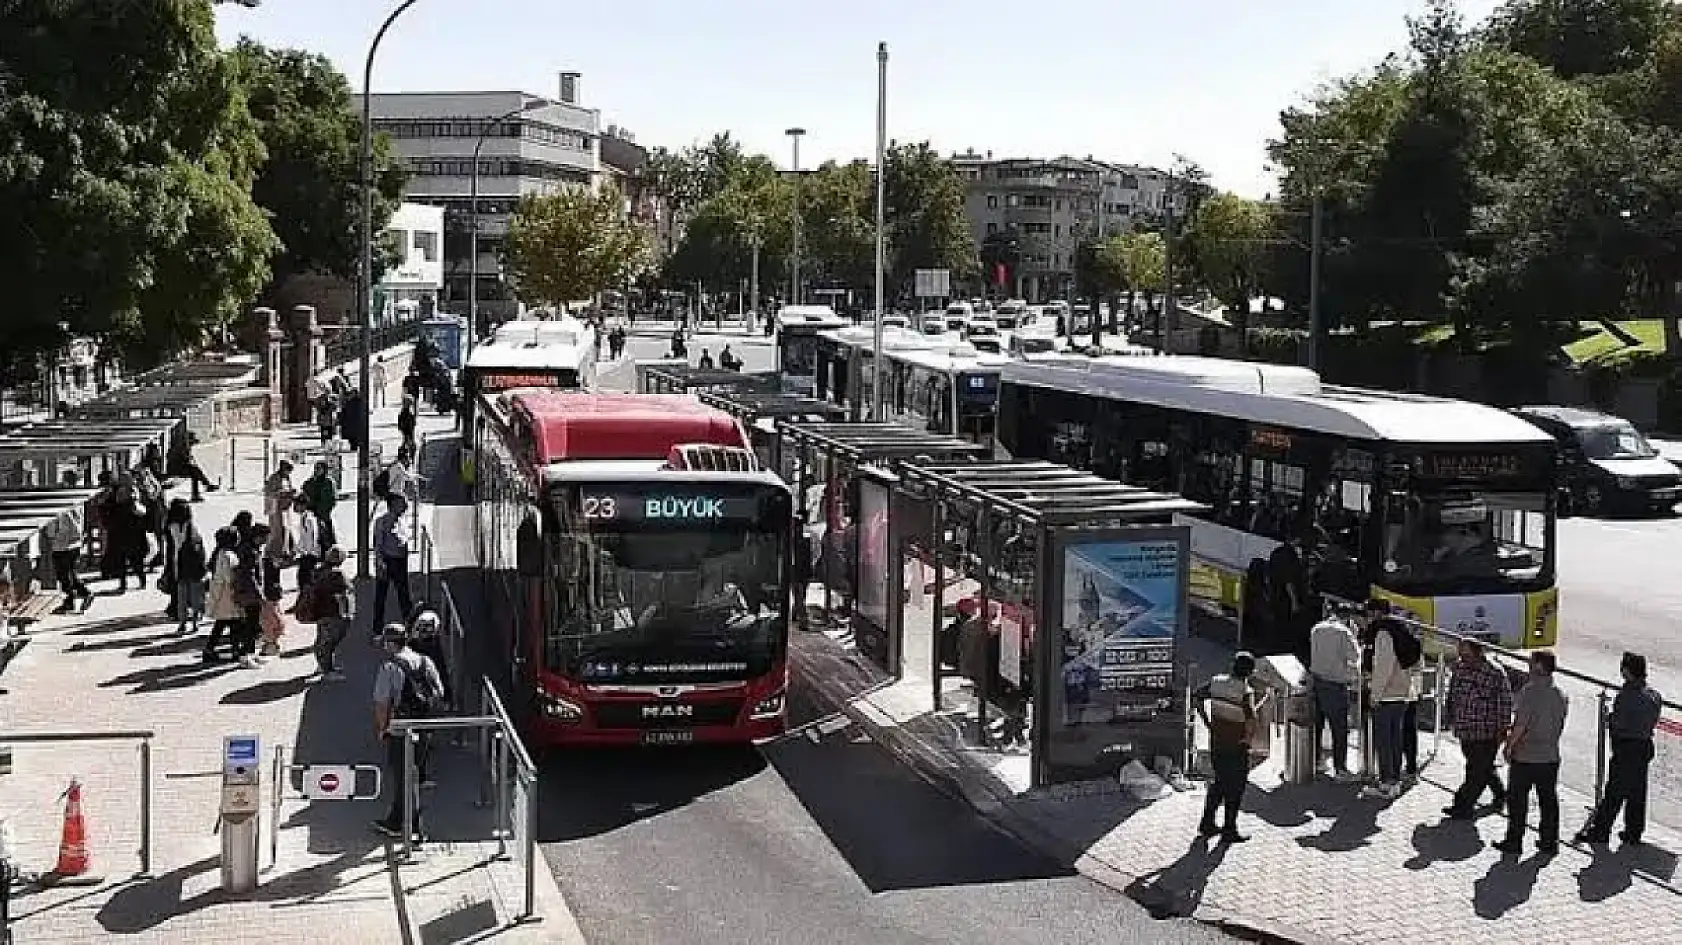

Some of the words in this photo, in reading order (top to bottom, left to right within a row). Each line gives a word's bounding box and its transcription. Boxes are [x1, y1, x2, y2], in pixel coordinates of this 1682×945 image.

[583, 496, 616, 518] 23
[645, 495, 723, 517] BÜYÜK
[641, 705, 693, 717] MAN
